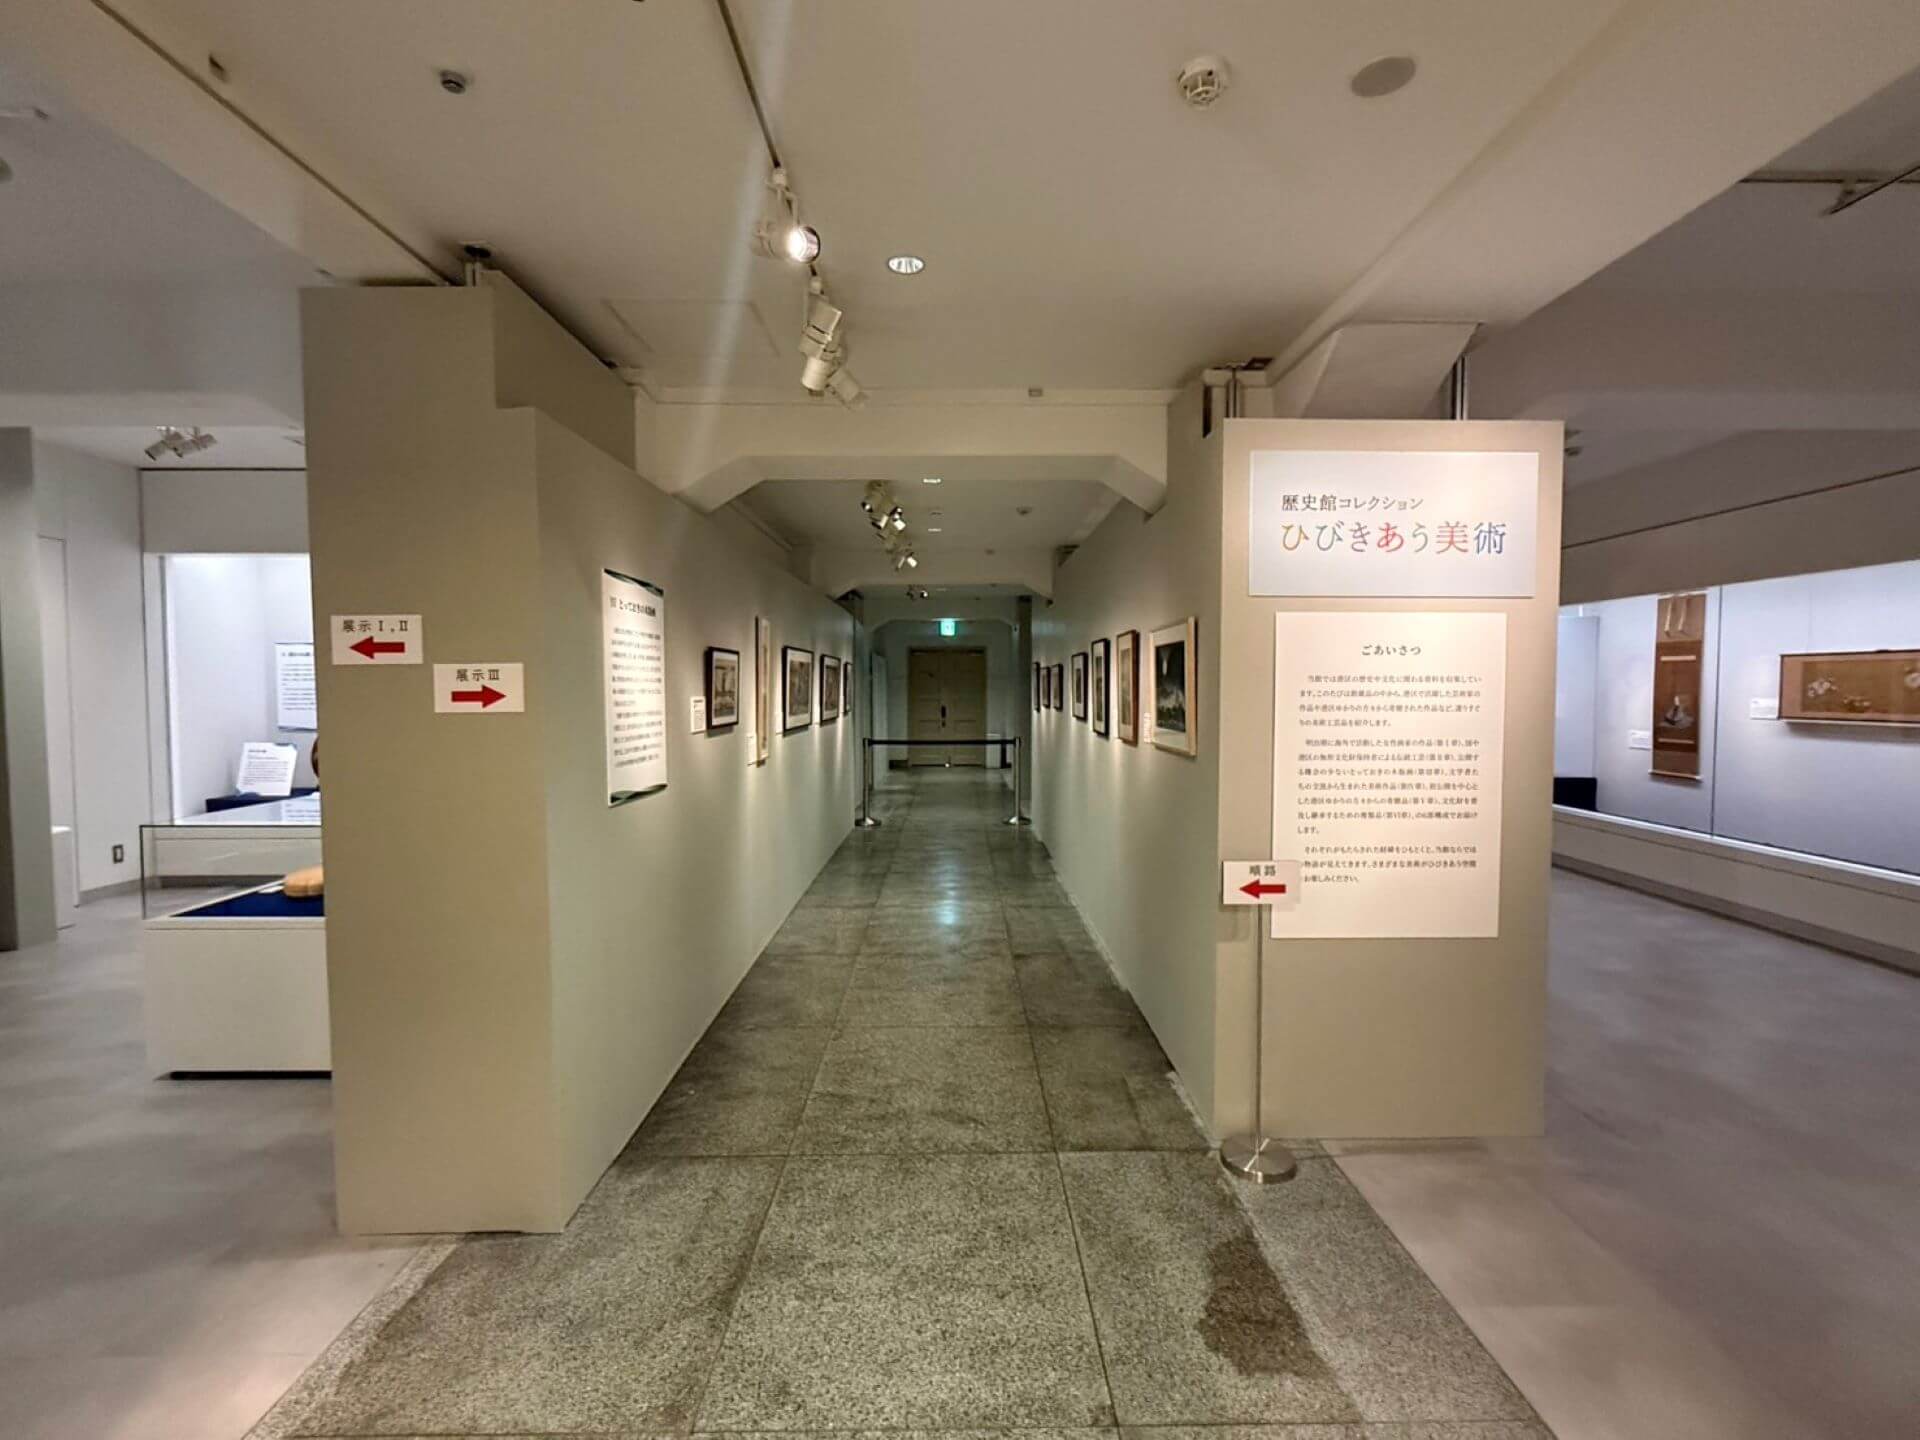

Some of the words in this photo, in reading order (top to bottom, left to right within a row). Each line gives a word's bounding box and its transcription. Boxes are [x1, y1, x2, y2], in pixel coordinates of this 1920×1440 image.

[1281, 493, 1424, 512] 歴史館コレクション
[1281, 520, 1507, 555] ひびきあう美術
[1361, 644, 1422, 656] ごあいさつ
